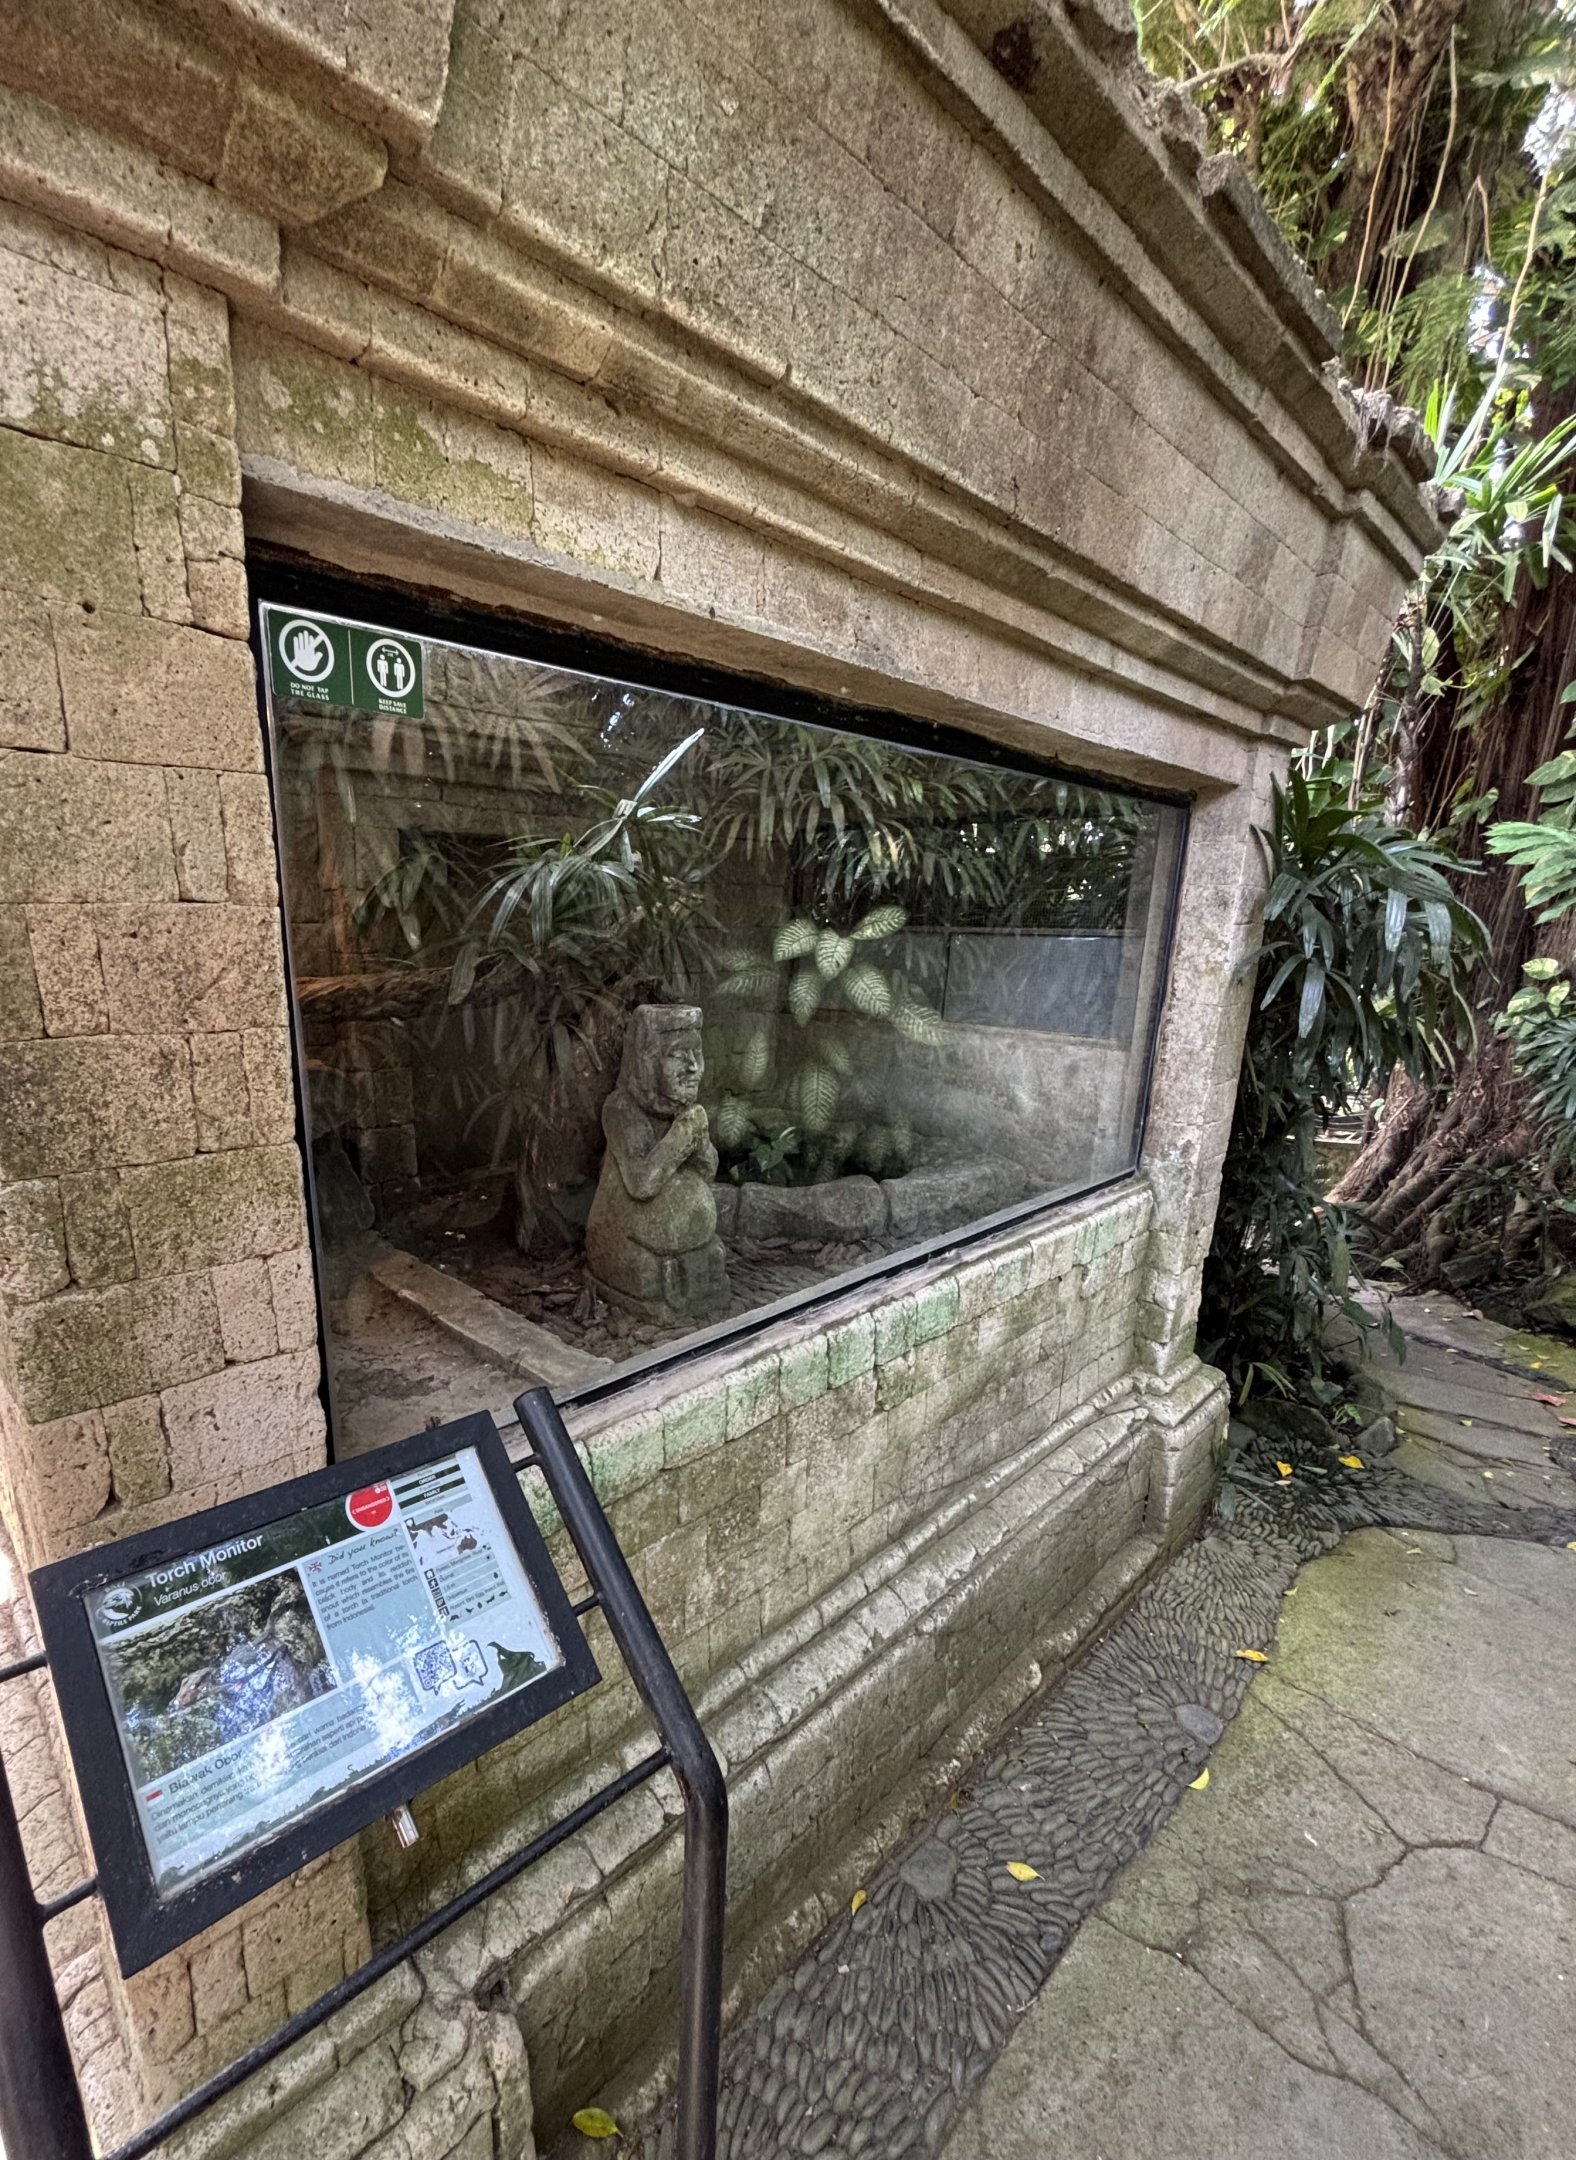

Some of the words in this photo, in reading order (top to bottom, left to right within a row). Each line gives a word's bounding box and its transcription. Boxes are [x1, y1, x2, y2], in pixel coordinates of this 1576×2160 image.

[291, 689, 305, 697] THE
[307, 691, 329, 701] GLASS
[317, 686, 329, 694] TAP
[378, 704, 407, 714] DISTANCE
[423, 1487, 441, 1498] FAMILY
[144, 1561, 196, 1588] Torch
[199, 1534, 263, 1569] Monitor
[328, 1550, 345, 1565] Did
[347, 1544, 366, 1559] you
[369, 1528, 398, 1547] know?
[327, 1567, 350, 1581] named
[351, 1559, 369, 1570] Torch
[370, 1549, 393, 1562] Monitor
[340, 1583, 357, 1595] body
[361, 1575, 374, 1586] and
[390, 1559, 413, 1572] reddish
[367, 1565, 378, 1573] the
[378, 1558, 393, 1569] color
[153, 1582, 199, 1607] Varanus
[201, 1571, 227, 1587] obor
[321, 1600, 340, 1613] snout
[341, 1592, 360, 1604] which
[361, 1578, 393, 1594] resembles
[341, 1601, 359, 1614] torch
[370, 1583, 400, 1600] traditional
[402, 1574, 418, 1586] torch
[102, 1618, 128, 1627] REPTILE
[128, 1605, 142, 1622] PARK
[326, 1619, 343, 1631] from
[168, 1766, 213, 1794] Biawak
[214, 1750, 243, 1770] Obor
